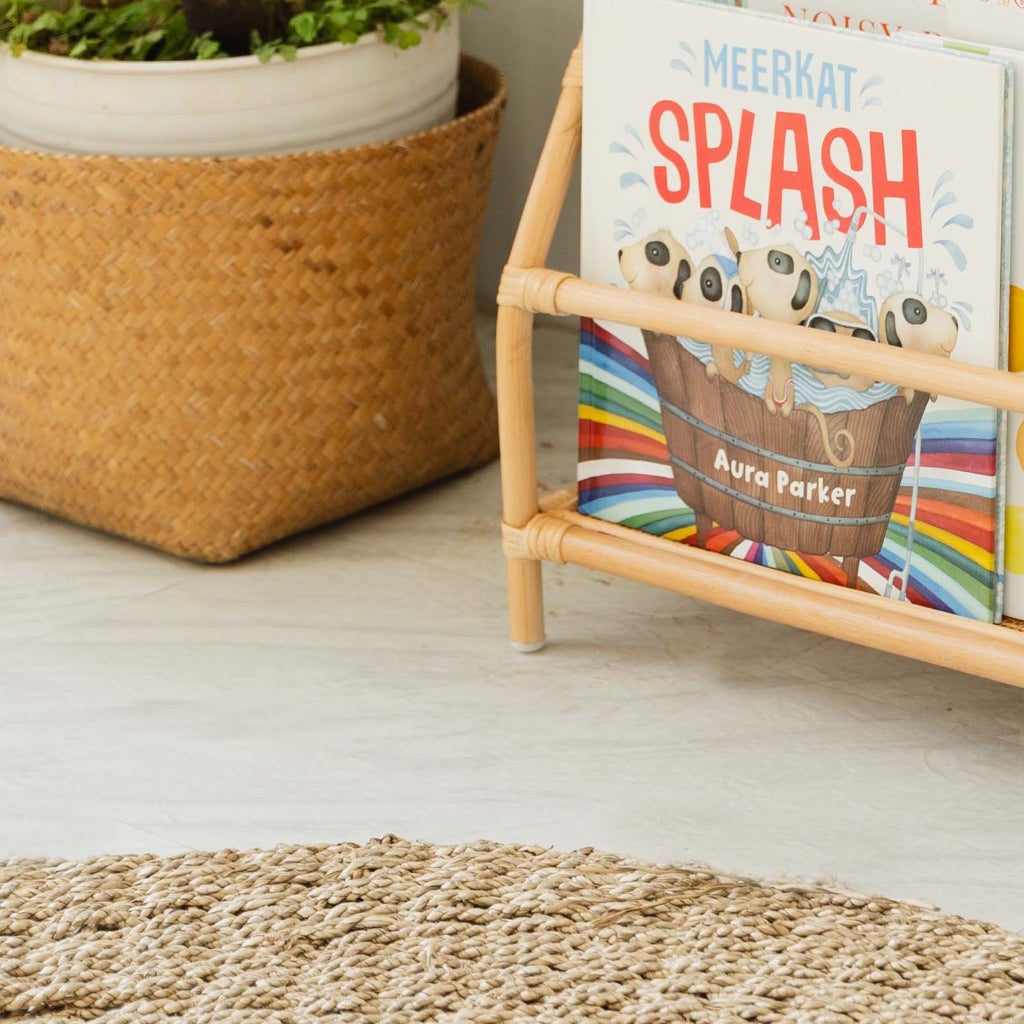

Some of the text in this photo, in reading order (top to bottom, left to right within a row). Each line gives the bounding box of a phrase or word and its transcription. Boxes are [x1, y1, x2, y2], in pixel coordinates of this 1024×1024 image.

[703, 39, 858, 113] MEERKAT
[649, 100, 923, 248] SPLASH
[714, 448, 856, 507] Aura Parker
